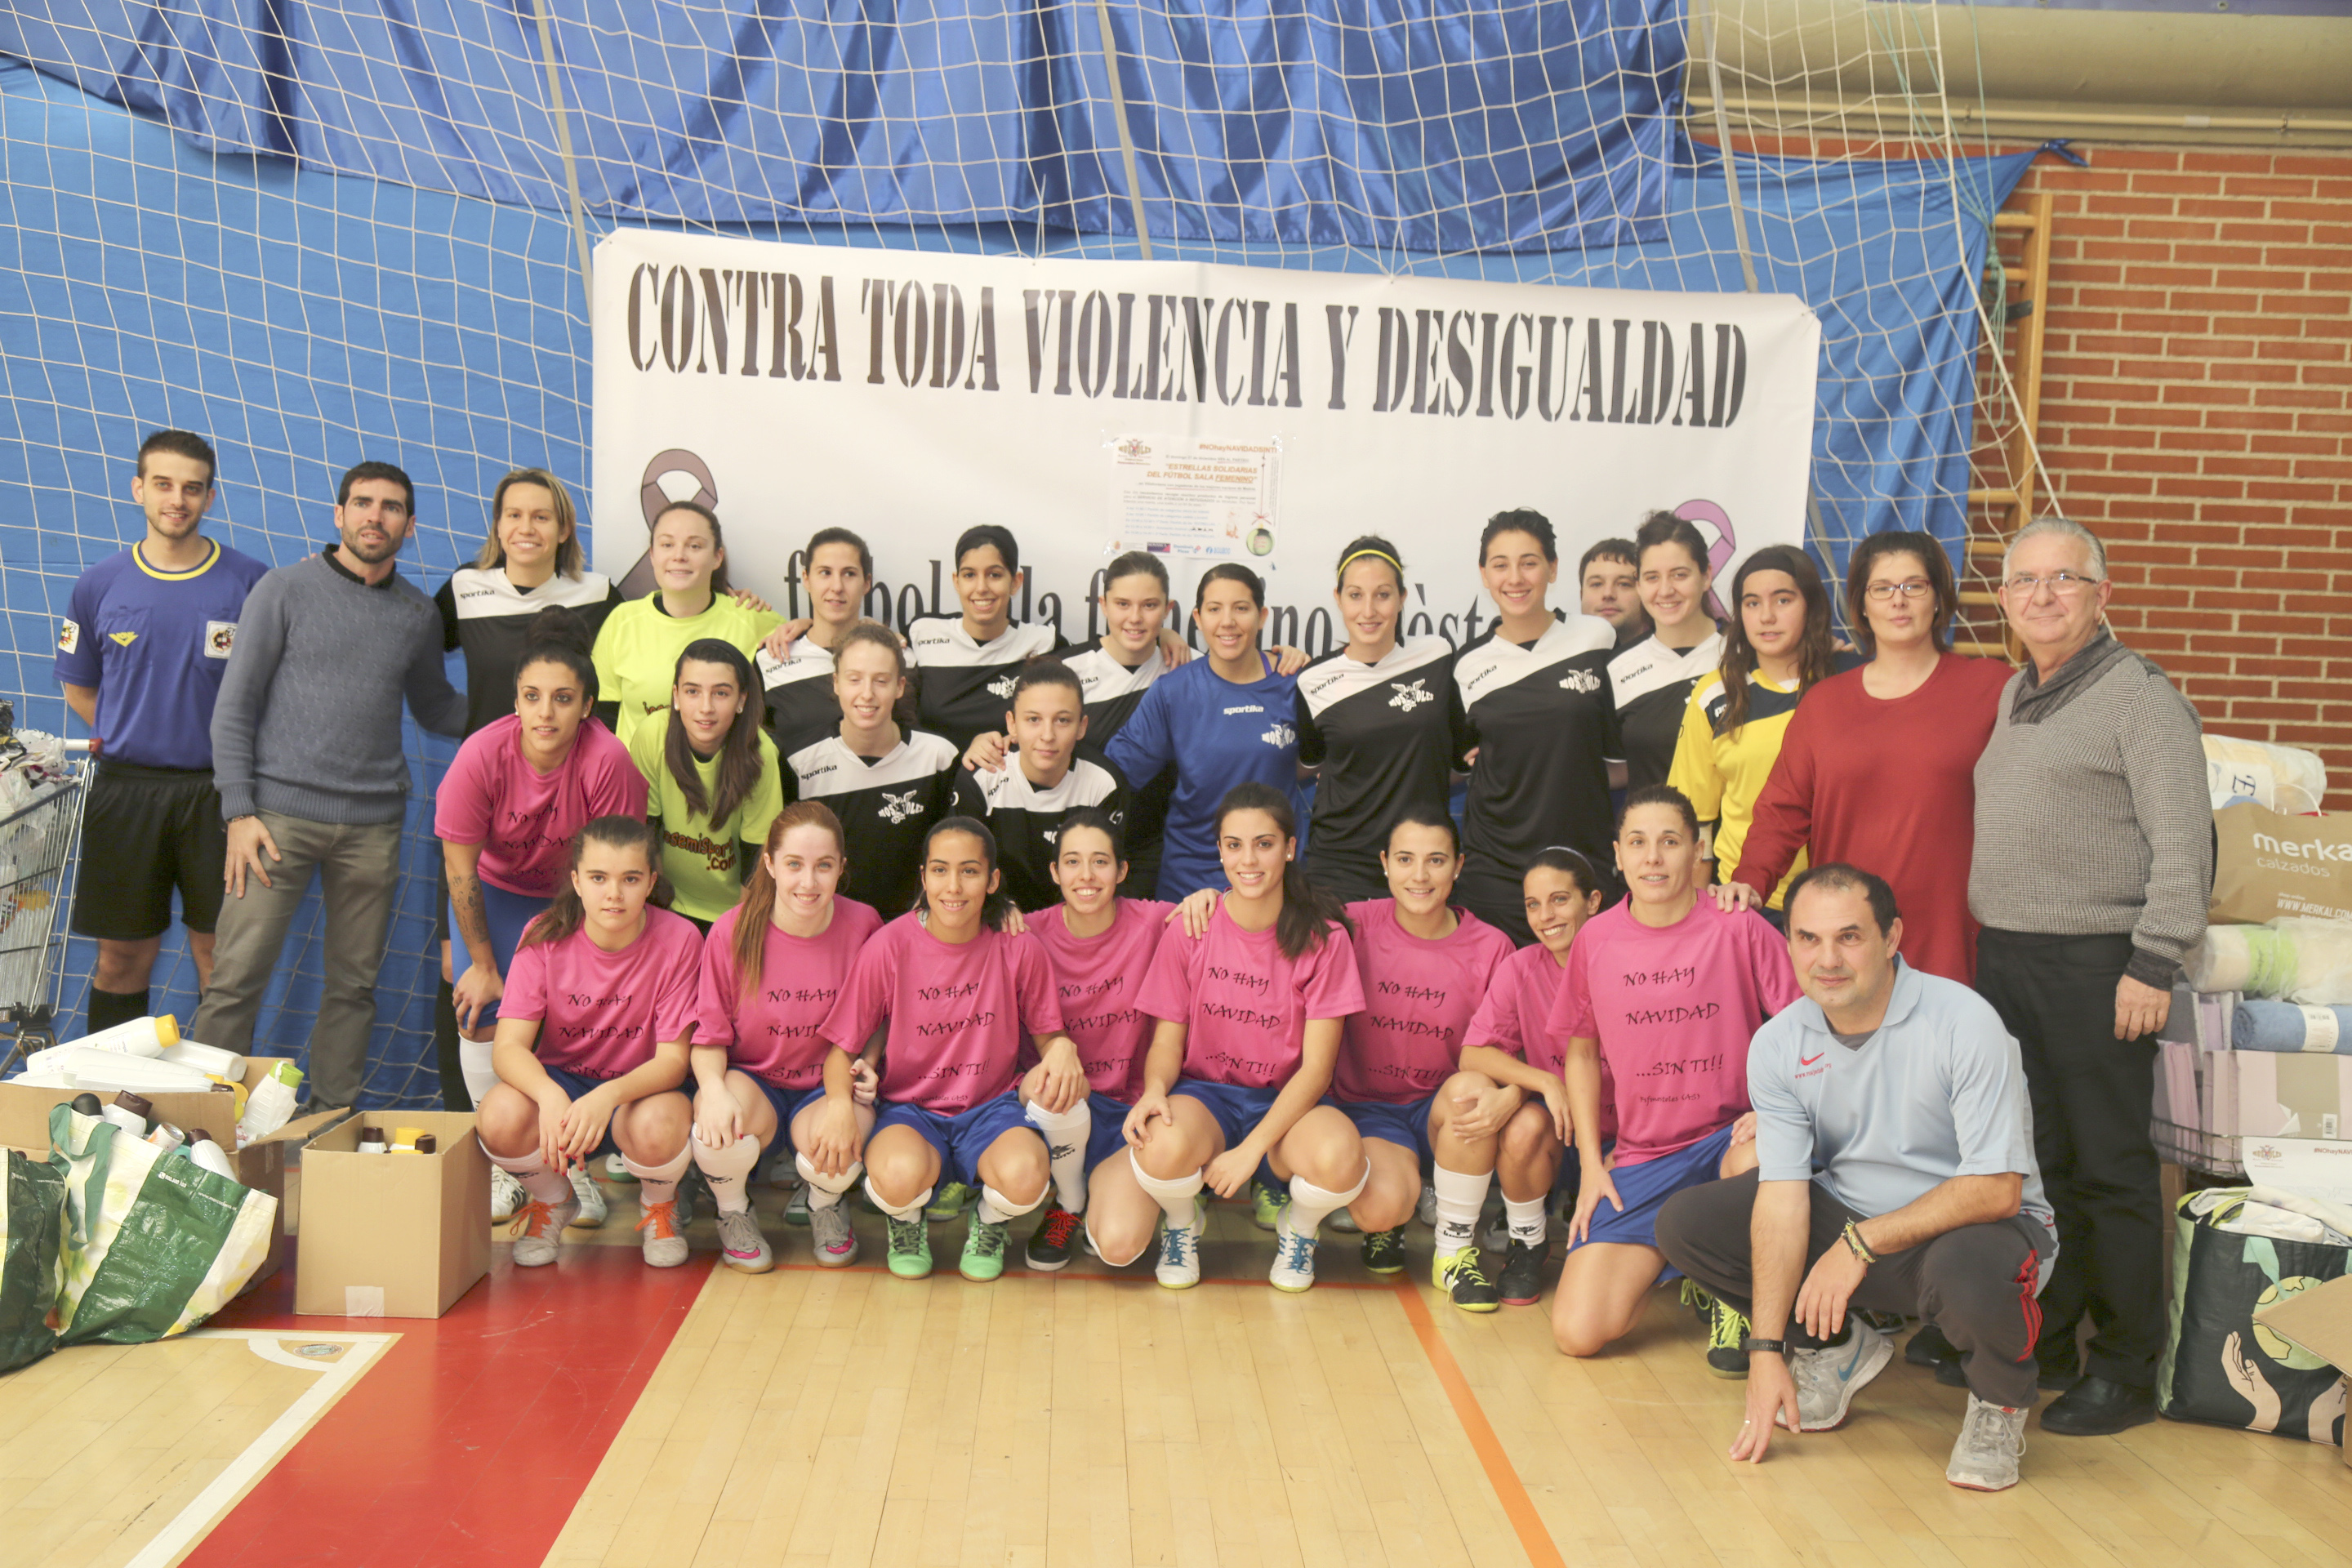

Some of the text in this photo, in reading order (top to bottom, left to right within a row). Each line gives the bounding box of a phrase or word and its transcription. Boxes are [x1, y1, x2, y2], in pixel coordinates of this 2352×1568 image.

[628, 261, 1747, 429] CONTRA TODA VIOLENCIA Y DESIGUALDAD
[1194, 472, 1214, 480] SALA
[917, 638, 950, 647] portika
[765, 658, 802, 674] sportika
[1310, 673, 1345, 695] sportika
[1223, 704, 1264, 715] sportika
[800, 764, 838, 781] sportika
[2256, 857, 2331, 878] calzados
[1059, 976, 1124, 997] NO HAY
[1208, 967, 1270, 997] NO HAY
[1624, 967, 1695, 988] NO HAY
[568, 994, 591, 1007] NO
[768, 988, 837, 1009] NO HAY
[918, 987, 941, 1000] NO
[1379, 981, 1446, 1009] NO HAY
[1063, 1008, 1144, 1031] NAVIDAD
[1203, 1003, 1281, 1030] NAVIDAD
[1625, 1002, 1721, 1026] NAVIDAD
[559, 1027, 644, 1040] NAVIDAD
[1370, 1016, 1454, 1041] NAVIDAD
[965, 1058, 991, 1076] TI!!
[1246, 1061, 1276, 1077] TI!!
[1637, 1054, 1724, 1077] ...SIN TI!!
